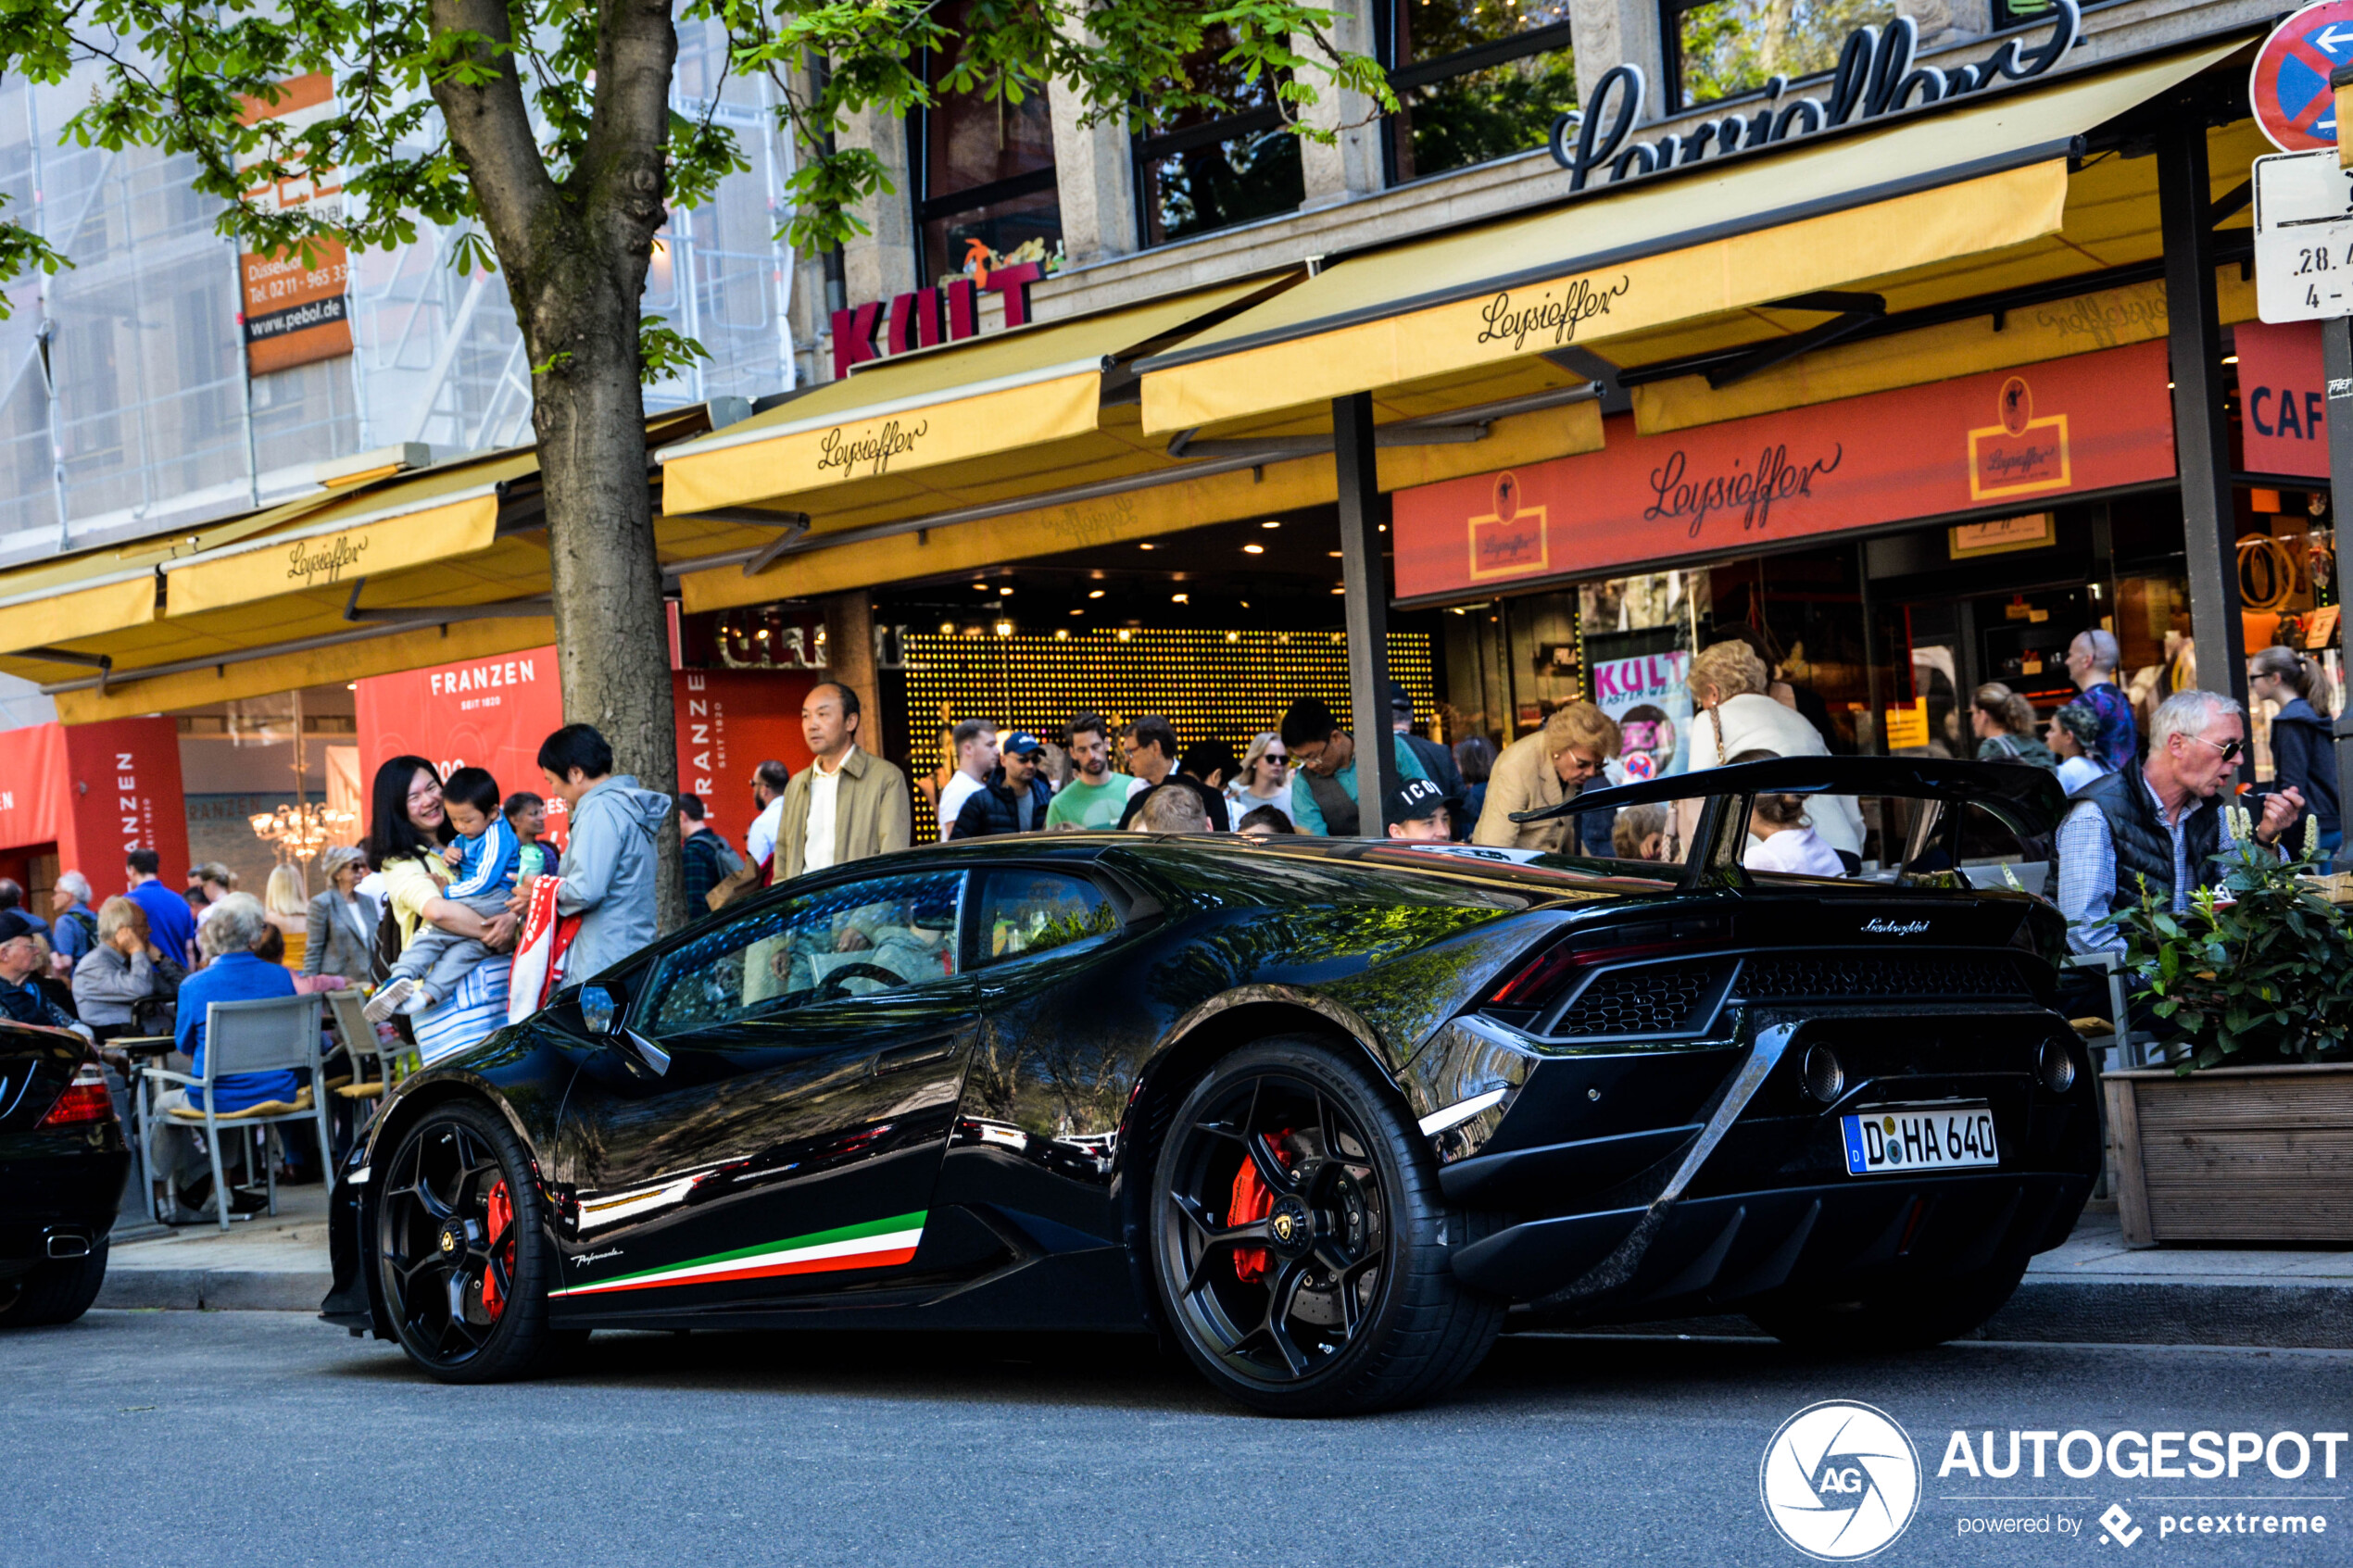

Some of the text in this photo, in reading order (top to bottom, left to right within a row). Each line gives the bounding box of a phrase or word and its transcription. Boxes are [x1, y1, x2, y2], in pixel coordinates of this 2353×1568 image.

[249, 284, 268, 304] Tel.
[270, 277, 296, 298] 0211
[307, 269, 330, 289] 965
[251, 300, 341, 335] www.pebol.de
[1478, 275, 1629, 351] Leysieffer
[818, 420, 927, 477] Leysieffer
[1643, 442, 1843, 538] Leysieffer
[287, 535, 369, 586] Leysieffer
[431, 659, 535, 696] FRANZEN
[1593, 650, 1687, 698] KULT
[461, 696, 501, 710] SEIT 1820
[714, 702, 726, 768] SEIT 1820
[1853, 1149, 1860, 1162] D
[1863, 1116, 1995, 1165] D HA 640
